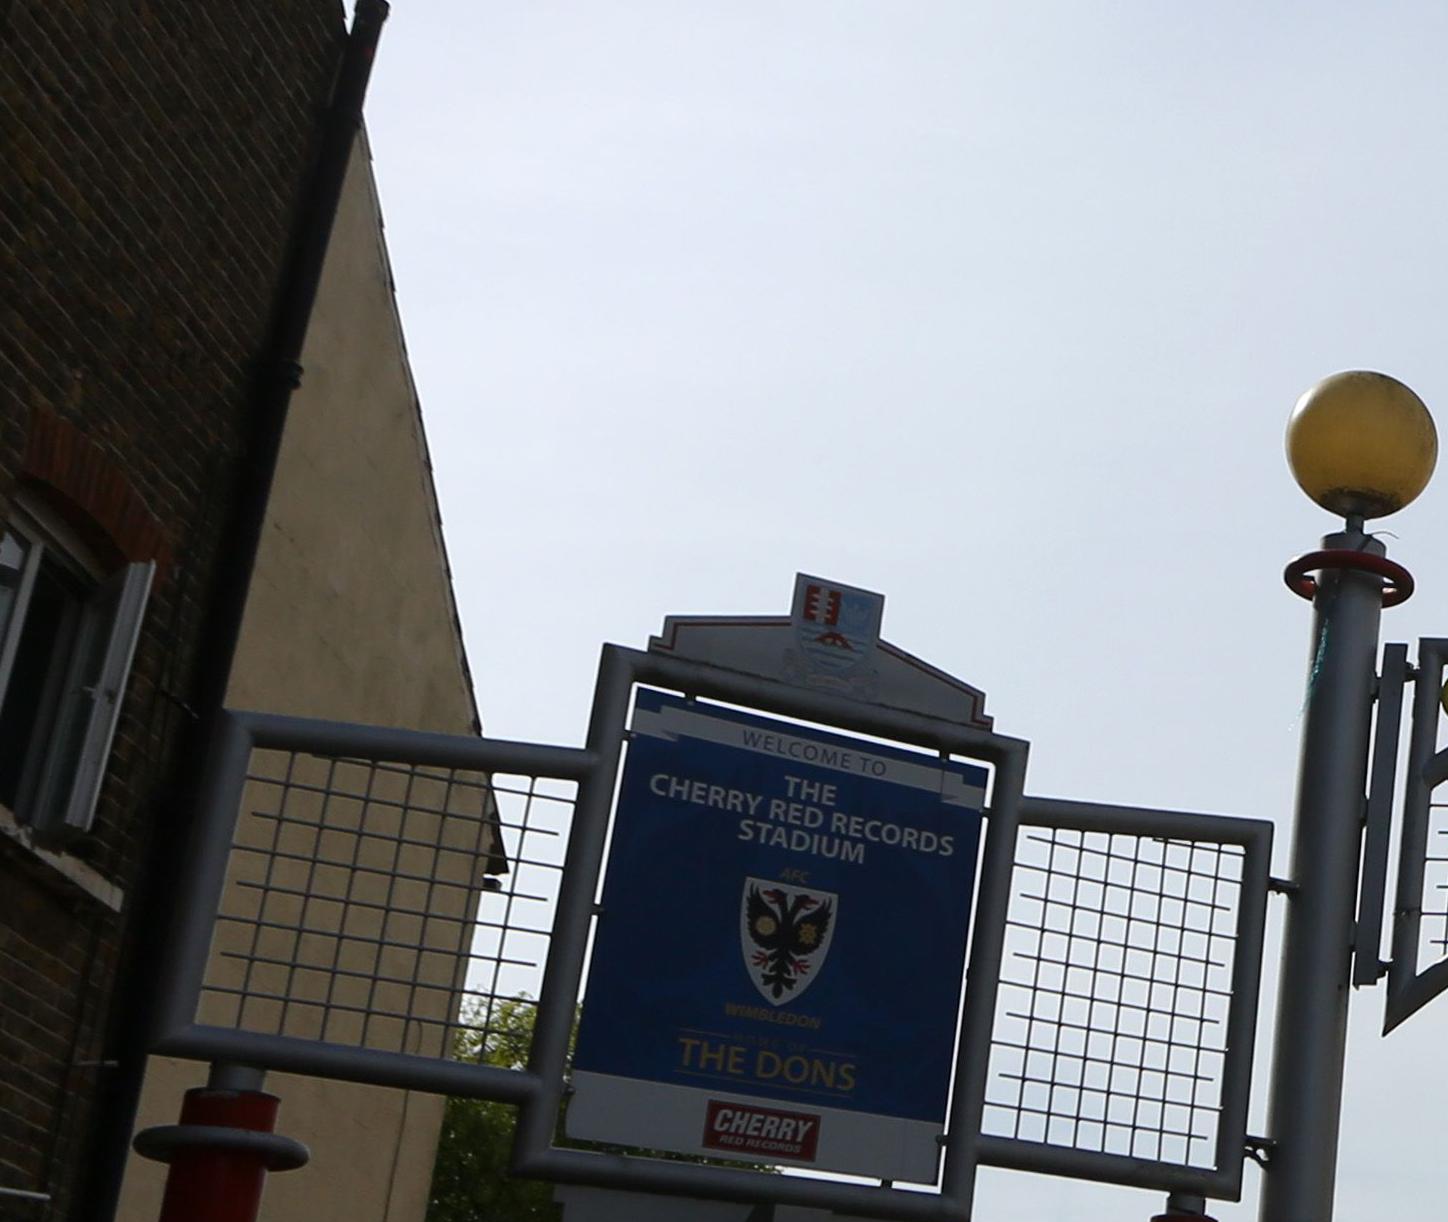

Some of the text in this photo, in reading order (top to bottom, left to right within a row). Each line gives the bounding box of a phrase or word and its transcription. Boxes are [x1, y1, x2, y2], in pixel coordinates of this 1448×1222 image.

[742, 730, 887, 776] WELCOME TO
[784, 776, 838, 806] THE
[649, 774, 954, 856] CHERRY RED RECORDS
[737, 819, 865, 864] STADIUM
[779, 867, 811, 884] AFC
[725, 1002, 822, 1030] WIMBLEDON
[678, 1038, 857, 1090] THE DONS
[713, 1109, 814, 1142] CHERRY
[719, 1135, 802, 1153] RED RECORDS
